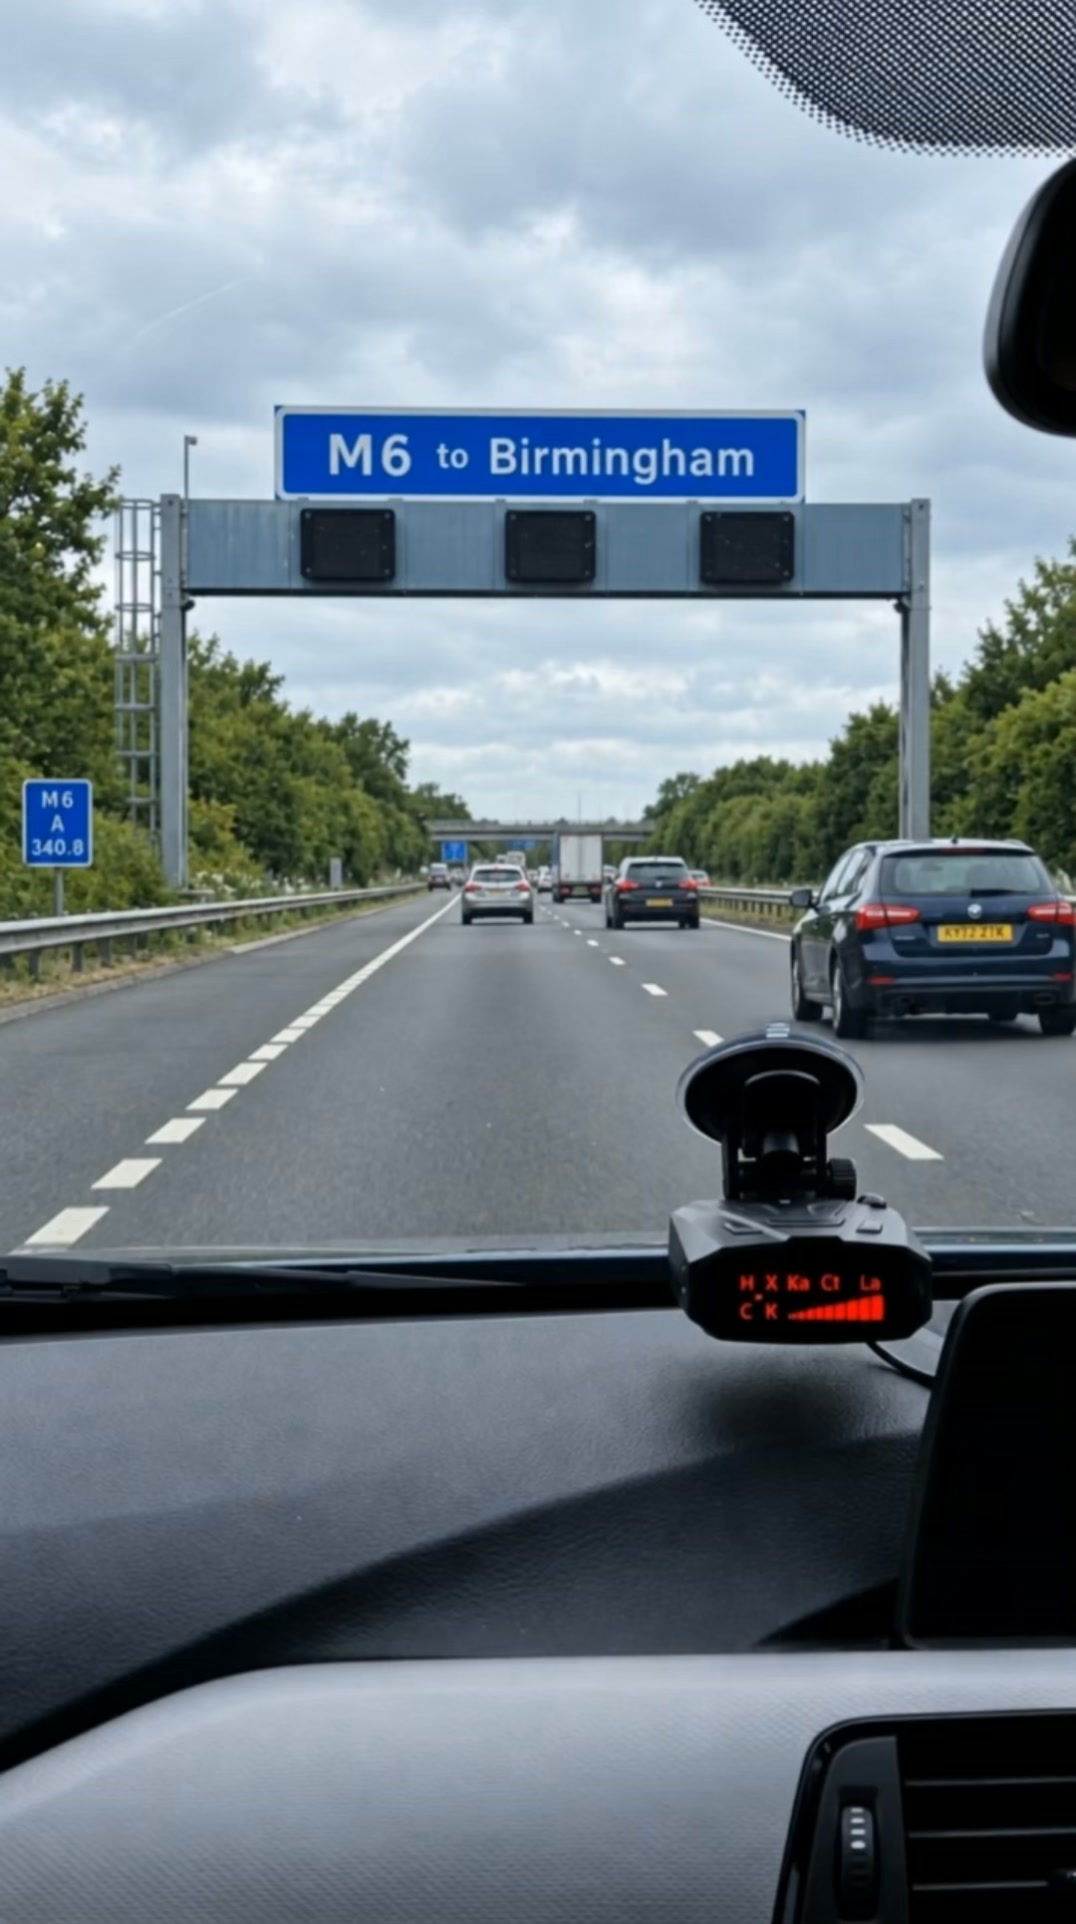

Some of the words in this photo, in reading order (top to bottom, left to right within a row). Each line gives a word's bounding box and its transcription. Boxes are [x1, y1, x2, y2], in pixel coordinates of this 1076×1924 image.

[329, 433, 412, 477] M6
[437, 443, 469, 469] to
[490, 437, 754, 485] Birmingham
[42, 790, 74, 809] M6
[51, 814, 65, 832] A
[32, 838, 84, 856] 340.8
[740, 1275, 754, 1291] H
[765, 1275, 778, 1291] X
[787, 1275, 810, 1291] Ka
[860, 1275, 881, 1291] La
[740, 1303, 752, 1319] C
[765, 1303, 778, 1319] K
